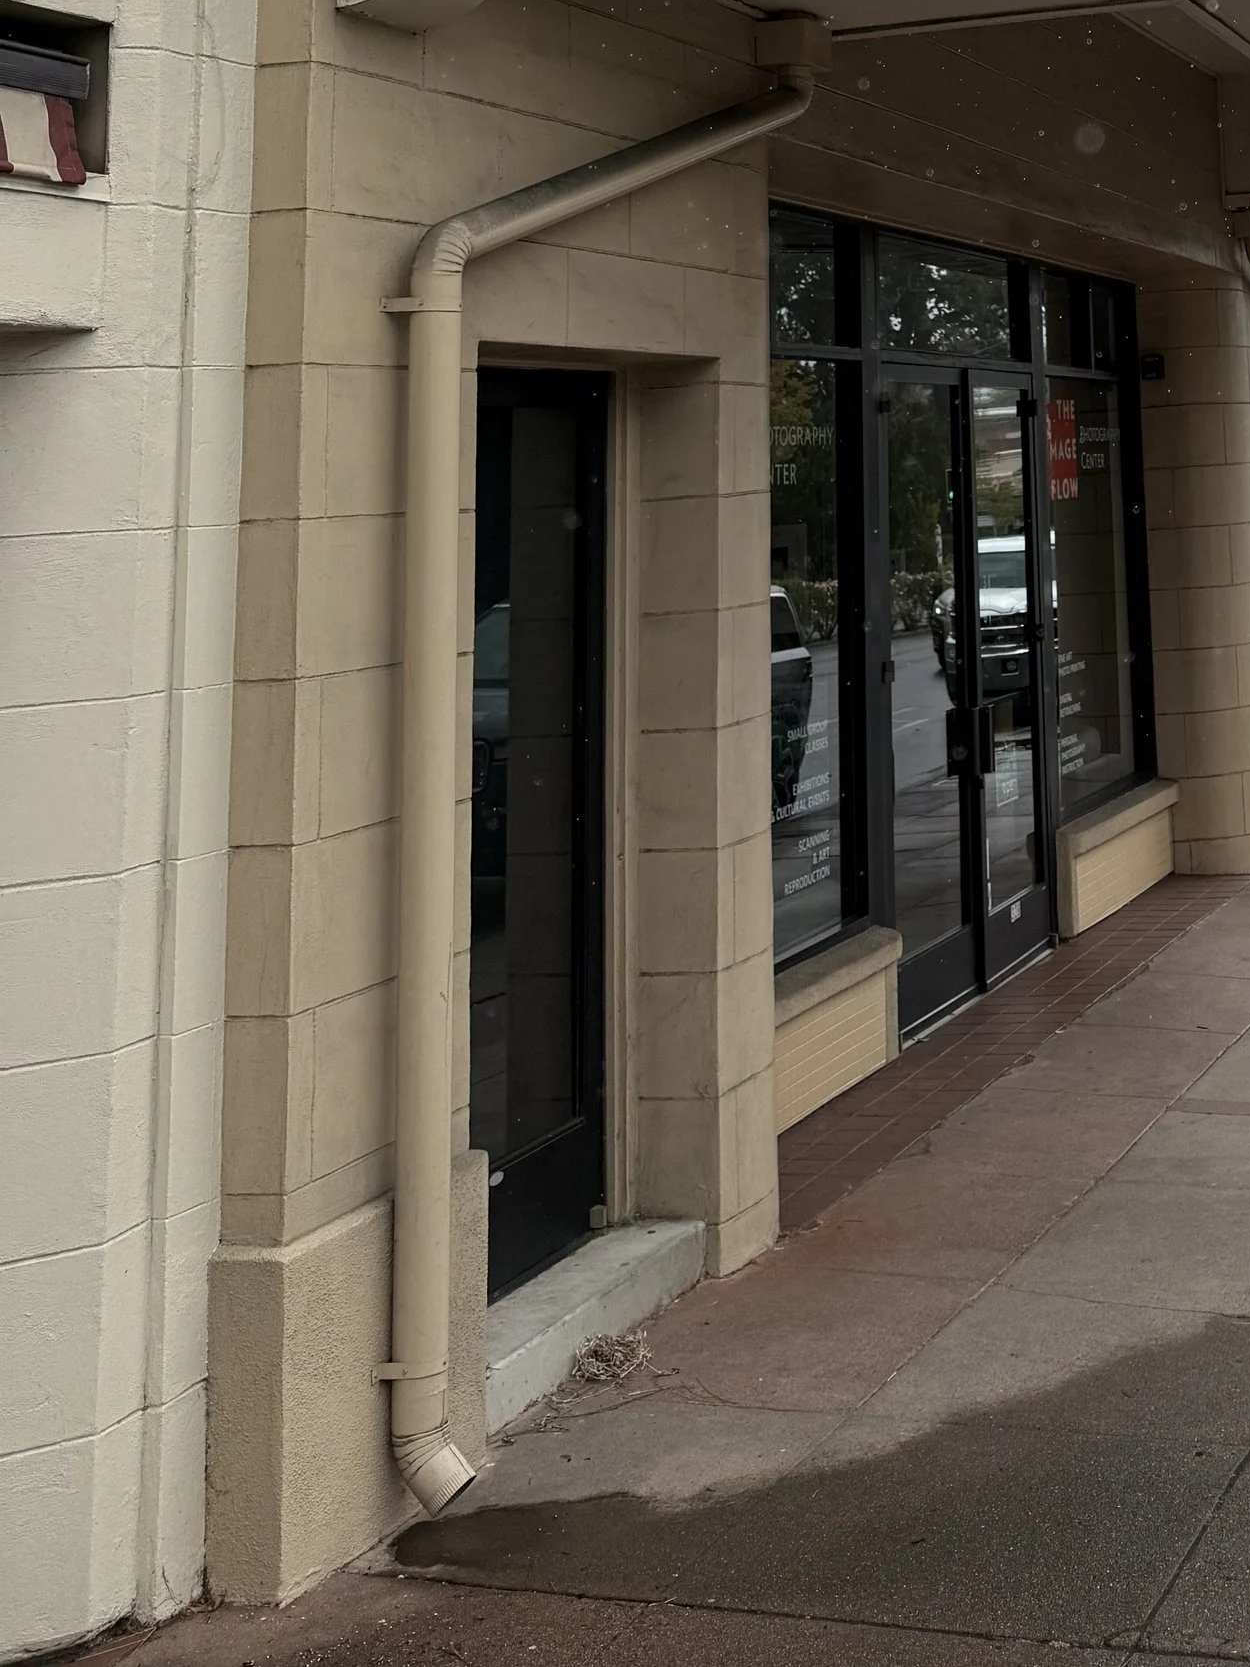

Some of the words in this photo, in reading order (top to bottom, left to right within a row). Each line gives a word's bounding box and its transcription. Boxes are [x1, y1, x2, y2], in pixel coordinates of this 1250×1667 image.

[1055, 399, 1076, 420] THE
[1080, 450, 1105, 470] CENTER
[1050, 477, 1079, 501] FLOW
[787, 726, 807, 742] SMALL
[805, 737, 828, 754] CLASSES
[793, 772, 829, 796] EXHIBITIONS
[776, 798, 806, 820] CULTURAL
[807, 789, 830, 808] EVENTS
[798, 830, 829, 852] SCANNING
[818, 846, 830, 863] ART
[784, 866, 830, 895] REPRODUCTION
